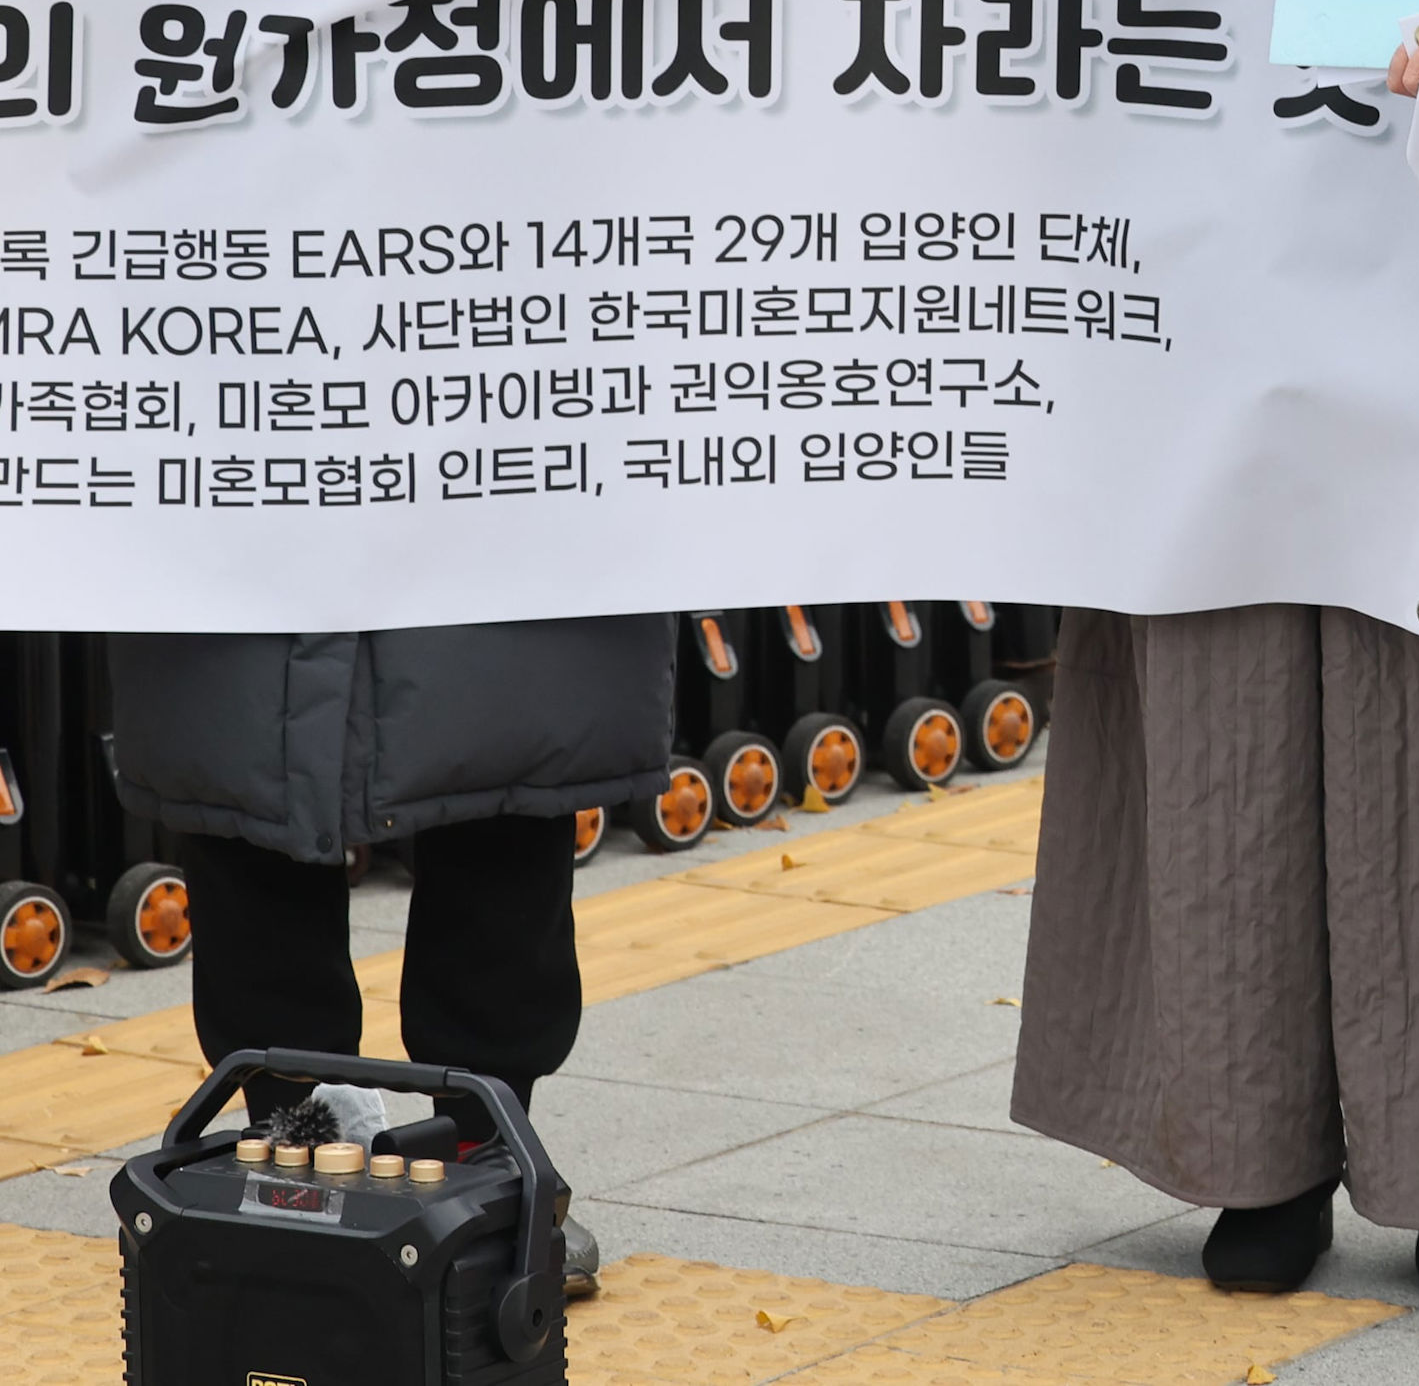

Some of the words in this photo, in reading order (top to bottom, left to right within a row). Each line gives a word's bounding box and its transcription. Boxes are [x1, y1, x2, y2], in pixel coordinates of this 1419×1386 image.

[1, 231, 49, 280] 록
[73, 229, 269, 280] 긴급행동
[293, 221, 509, 278] EARS와
[528, 216, 693, 268] 14개국
[716, 213, 836, 262] 29개
[861, 213, 1014, 260] 입양인
[1040, 214, 1139, 273] 단체,
[0, 308, 100, 354] RA
[123, 307, 340, 359] KOREA,
[363, 294, 566, 352] 사단법인
[590, 285, 1171, 351] 한국미혼모지원네트워크,
[220, 379, 369, 431] 미혼모
[392, 366, 651, 426] 아카이빙과
[671, 359, 1053, 413] 권익옹호연구소,
[159, 453, 415, 507] 미혼모협회
[439, 443, 602, 499] 인트리,
[624, 435, 775, 488] 국내외
[801, 431, 1009, 481] 입양인들
